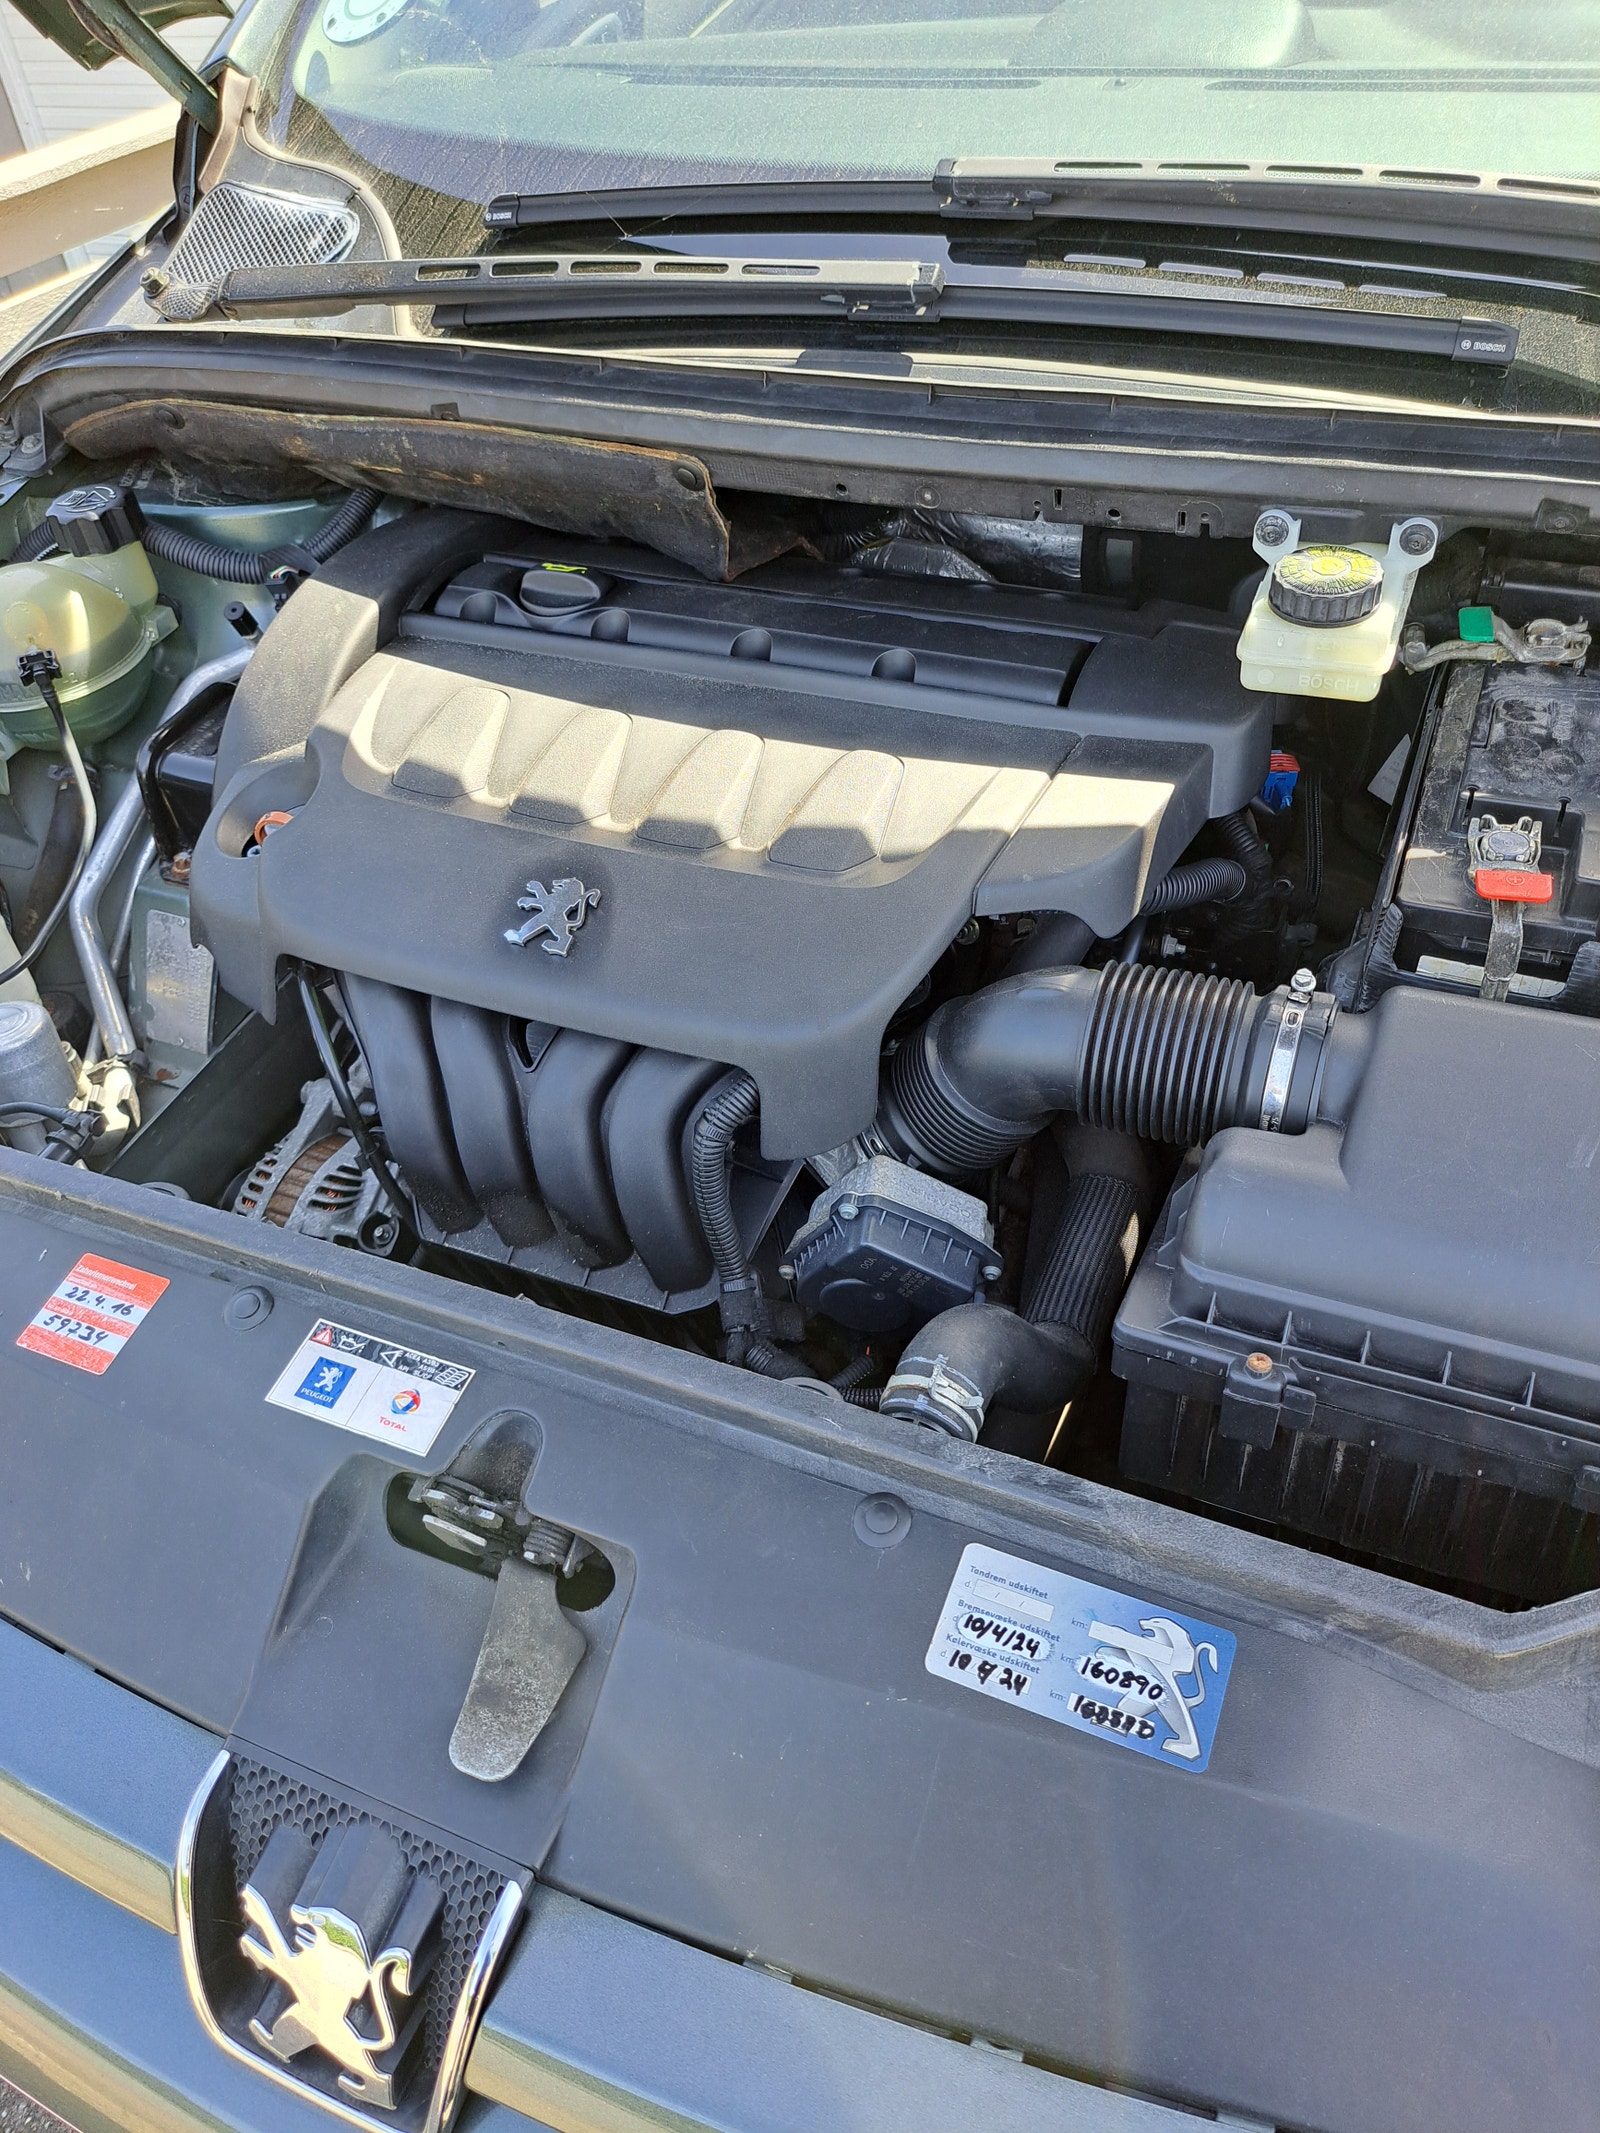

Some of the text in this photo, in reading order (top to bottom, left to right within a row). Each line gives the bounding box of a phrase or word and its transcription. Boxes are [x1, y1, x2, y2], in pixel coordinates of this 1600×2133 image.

[1473, 341, 1507, 353] BOSCH
[1298, 673, 1360, 692] BOSCH
[42, 1314, 109, 1346] 59734
[301, 1387, 334, 1404] PEUGEOT
[379, 1416, 407, 1432] TOTAL
[970, 1565, 1049, 1600] Tandrem udskiftet
[957, 1598, 1061, 1643] Bremsevæske udskiftet
[1071, 1617, 1088, 1631] km:
[963, 1613, 1041, 1659] 10/4/24
[946, 1633, 1041, 1675] Kølervæske udskiftet
[1080, 1656, 1164, 1701] 160890
[1049, 1689, 1067, 1701] km:
